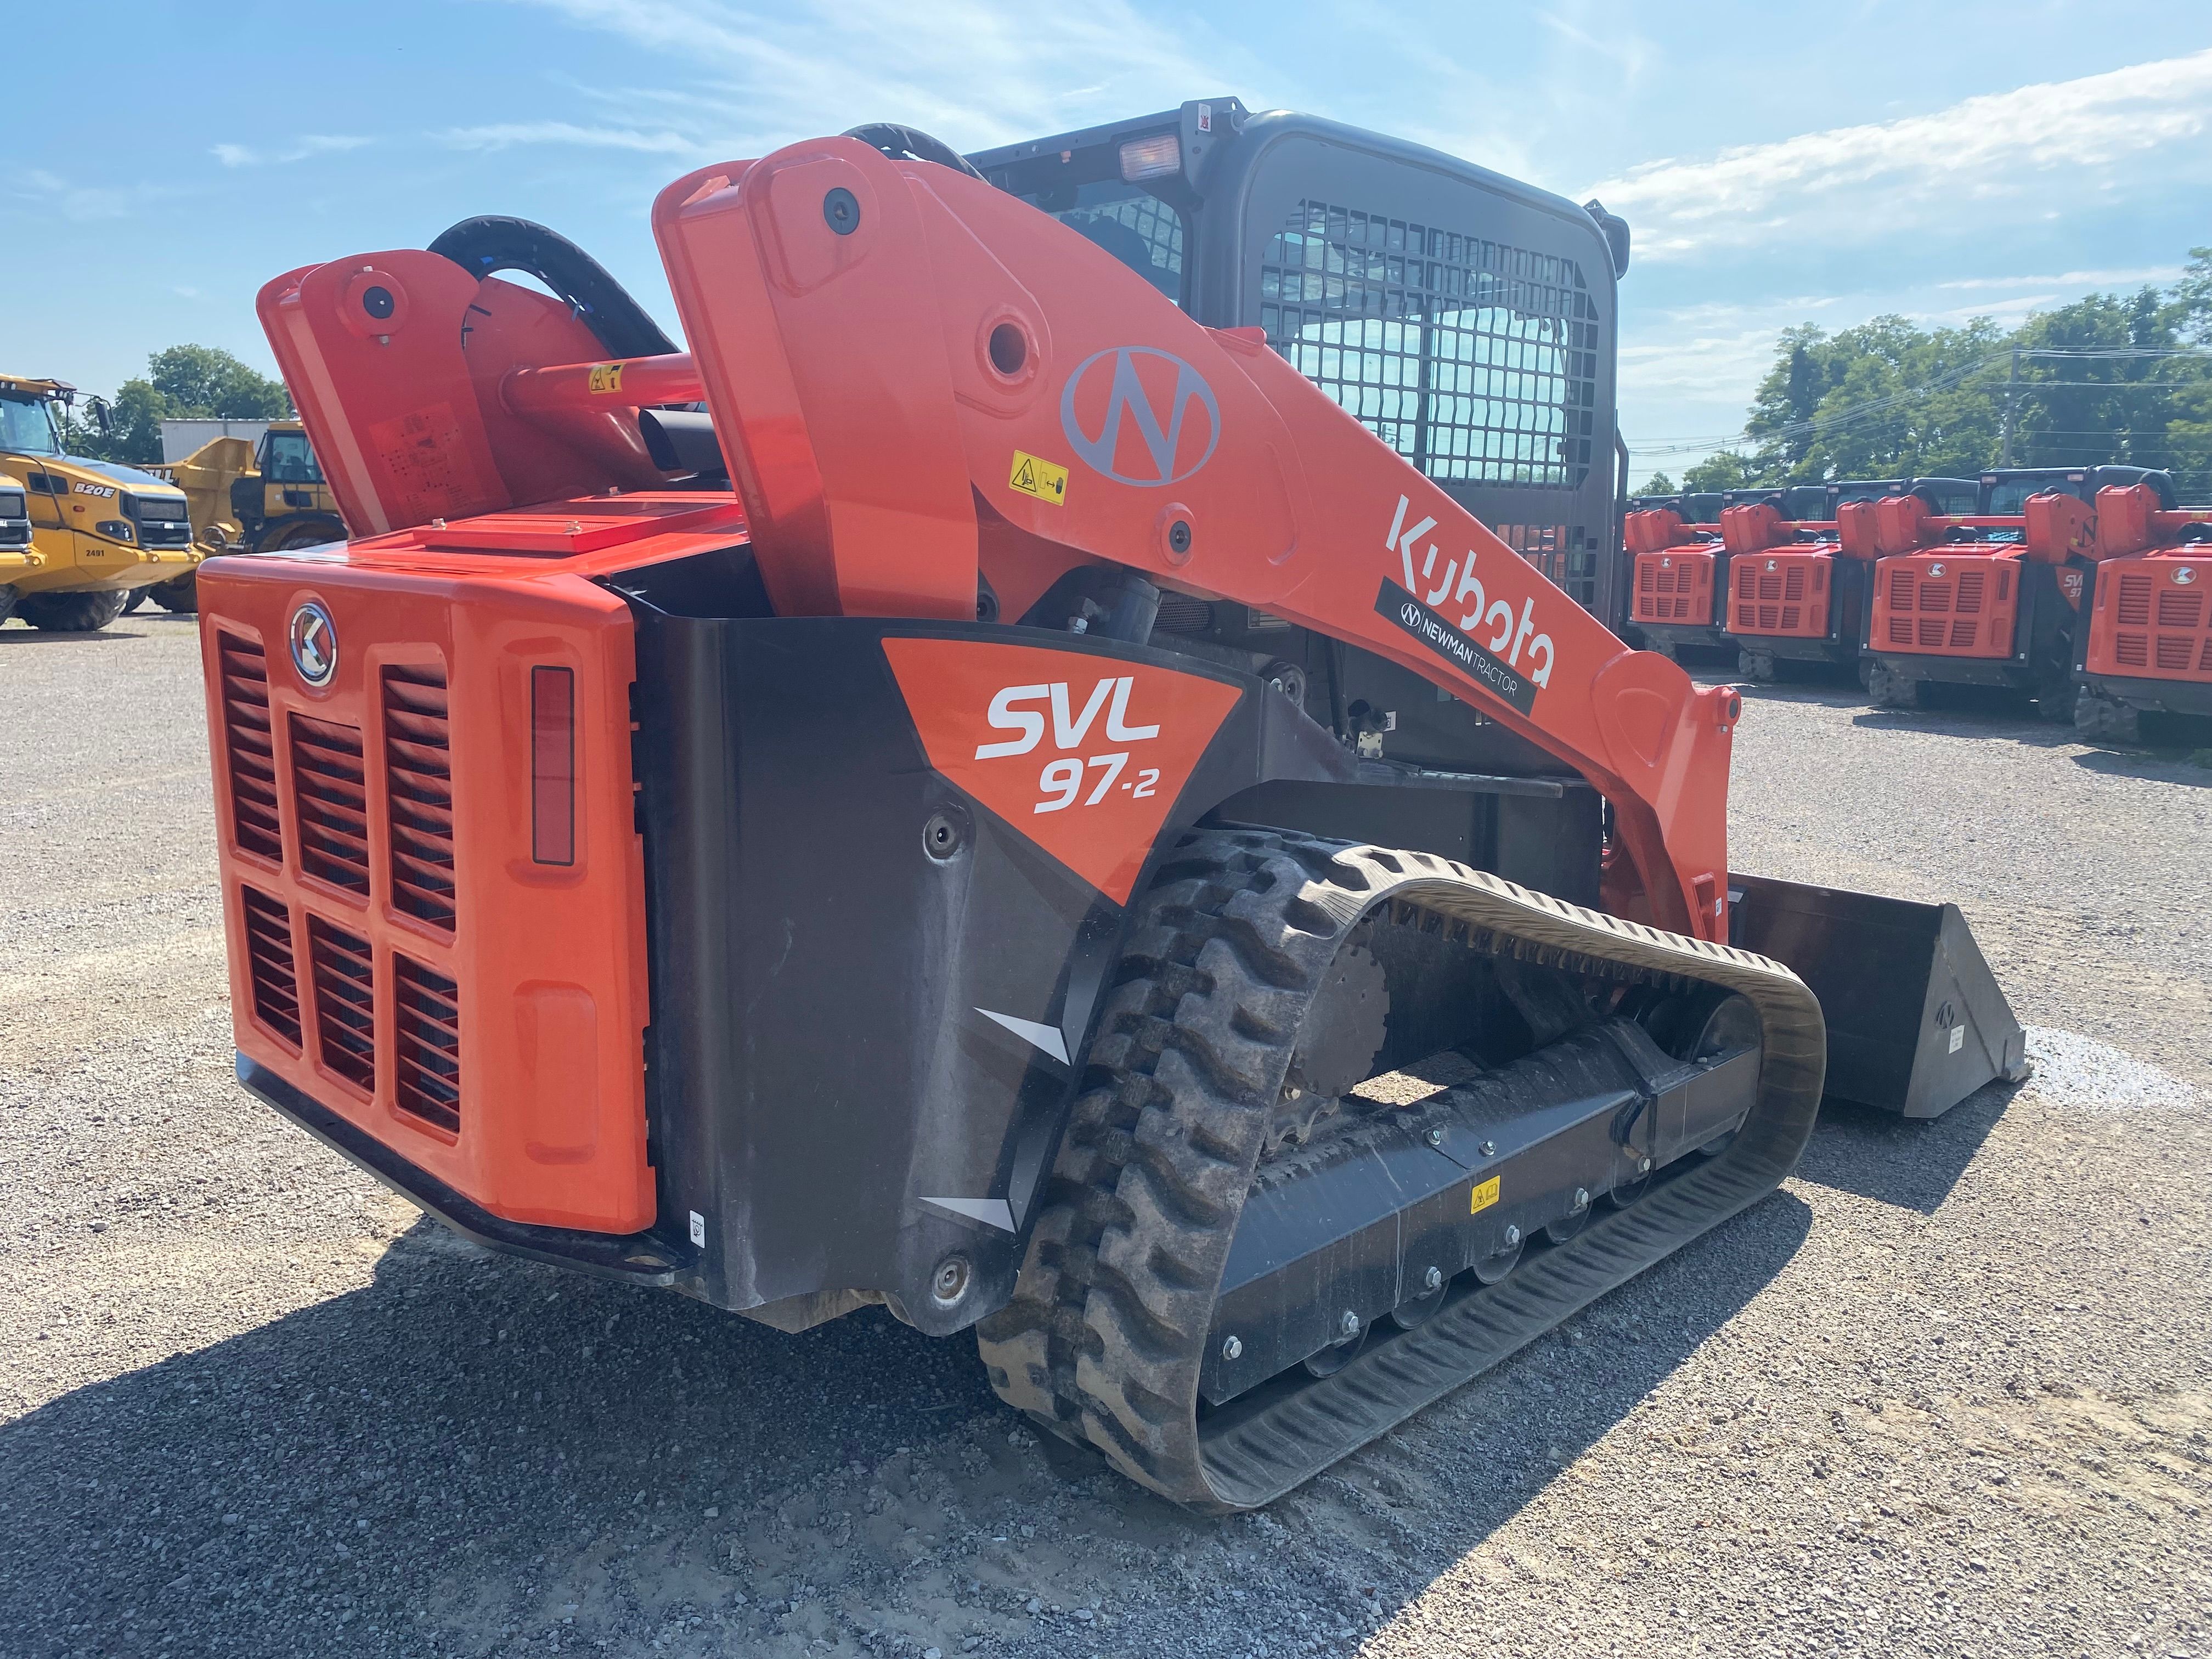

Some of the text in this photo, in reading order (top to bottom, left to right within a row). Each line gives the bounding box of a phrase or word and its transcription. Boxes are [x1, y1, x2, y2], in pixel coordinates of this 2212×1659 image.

[1060, 346, 1221, 487] N
[74, 482, 116, 498] B20E
[1386, 494, 1555, 689] Kubota
[974, 676, 1161, 760] SVL
[1033, 752, 1160, 814] 97-2
